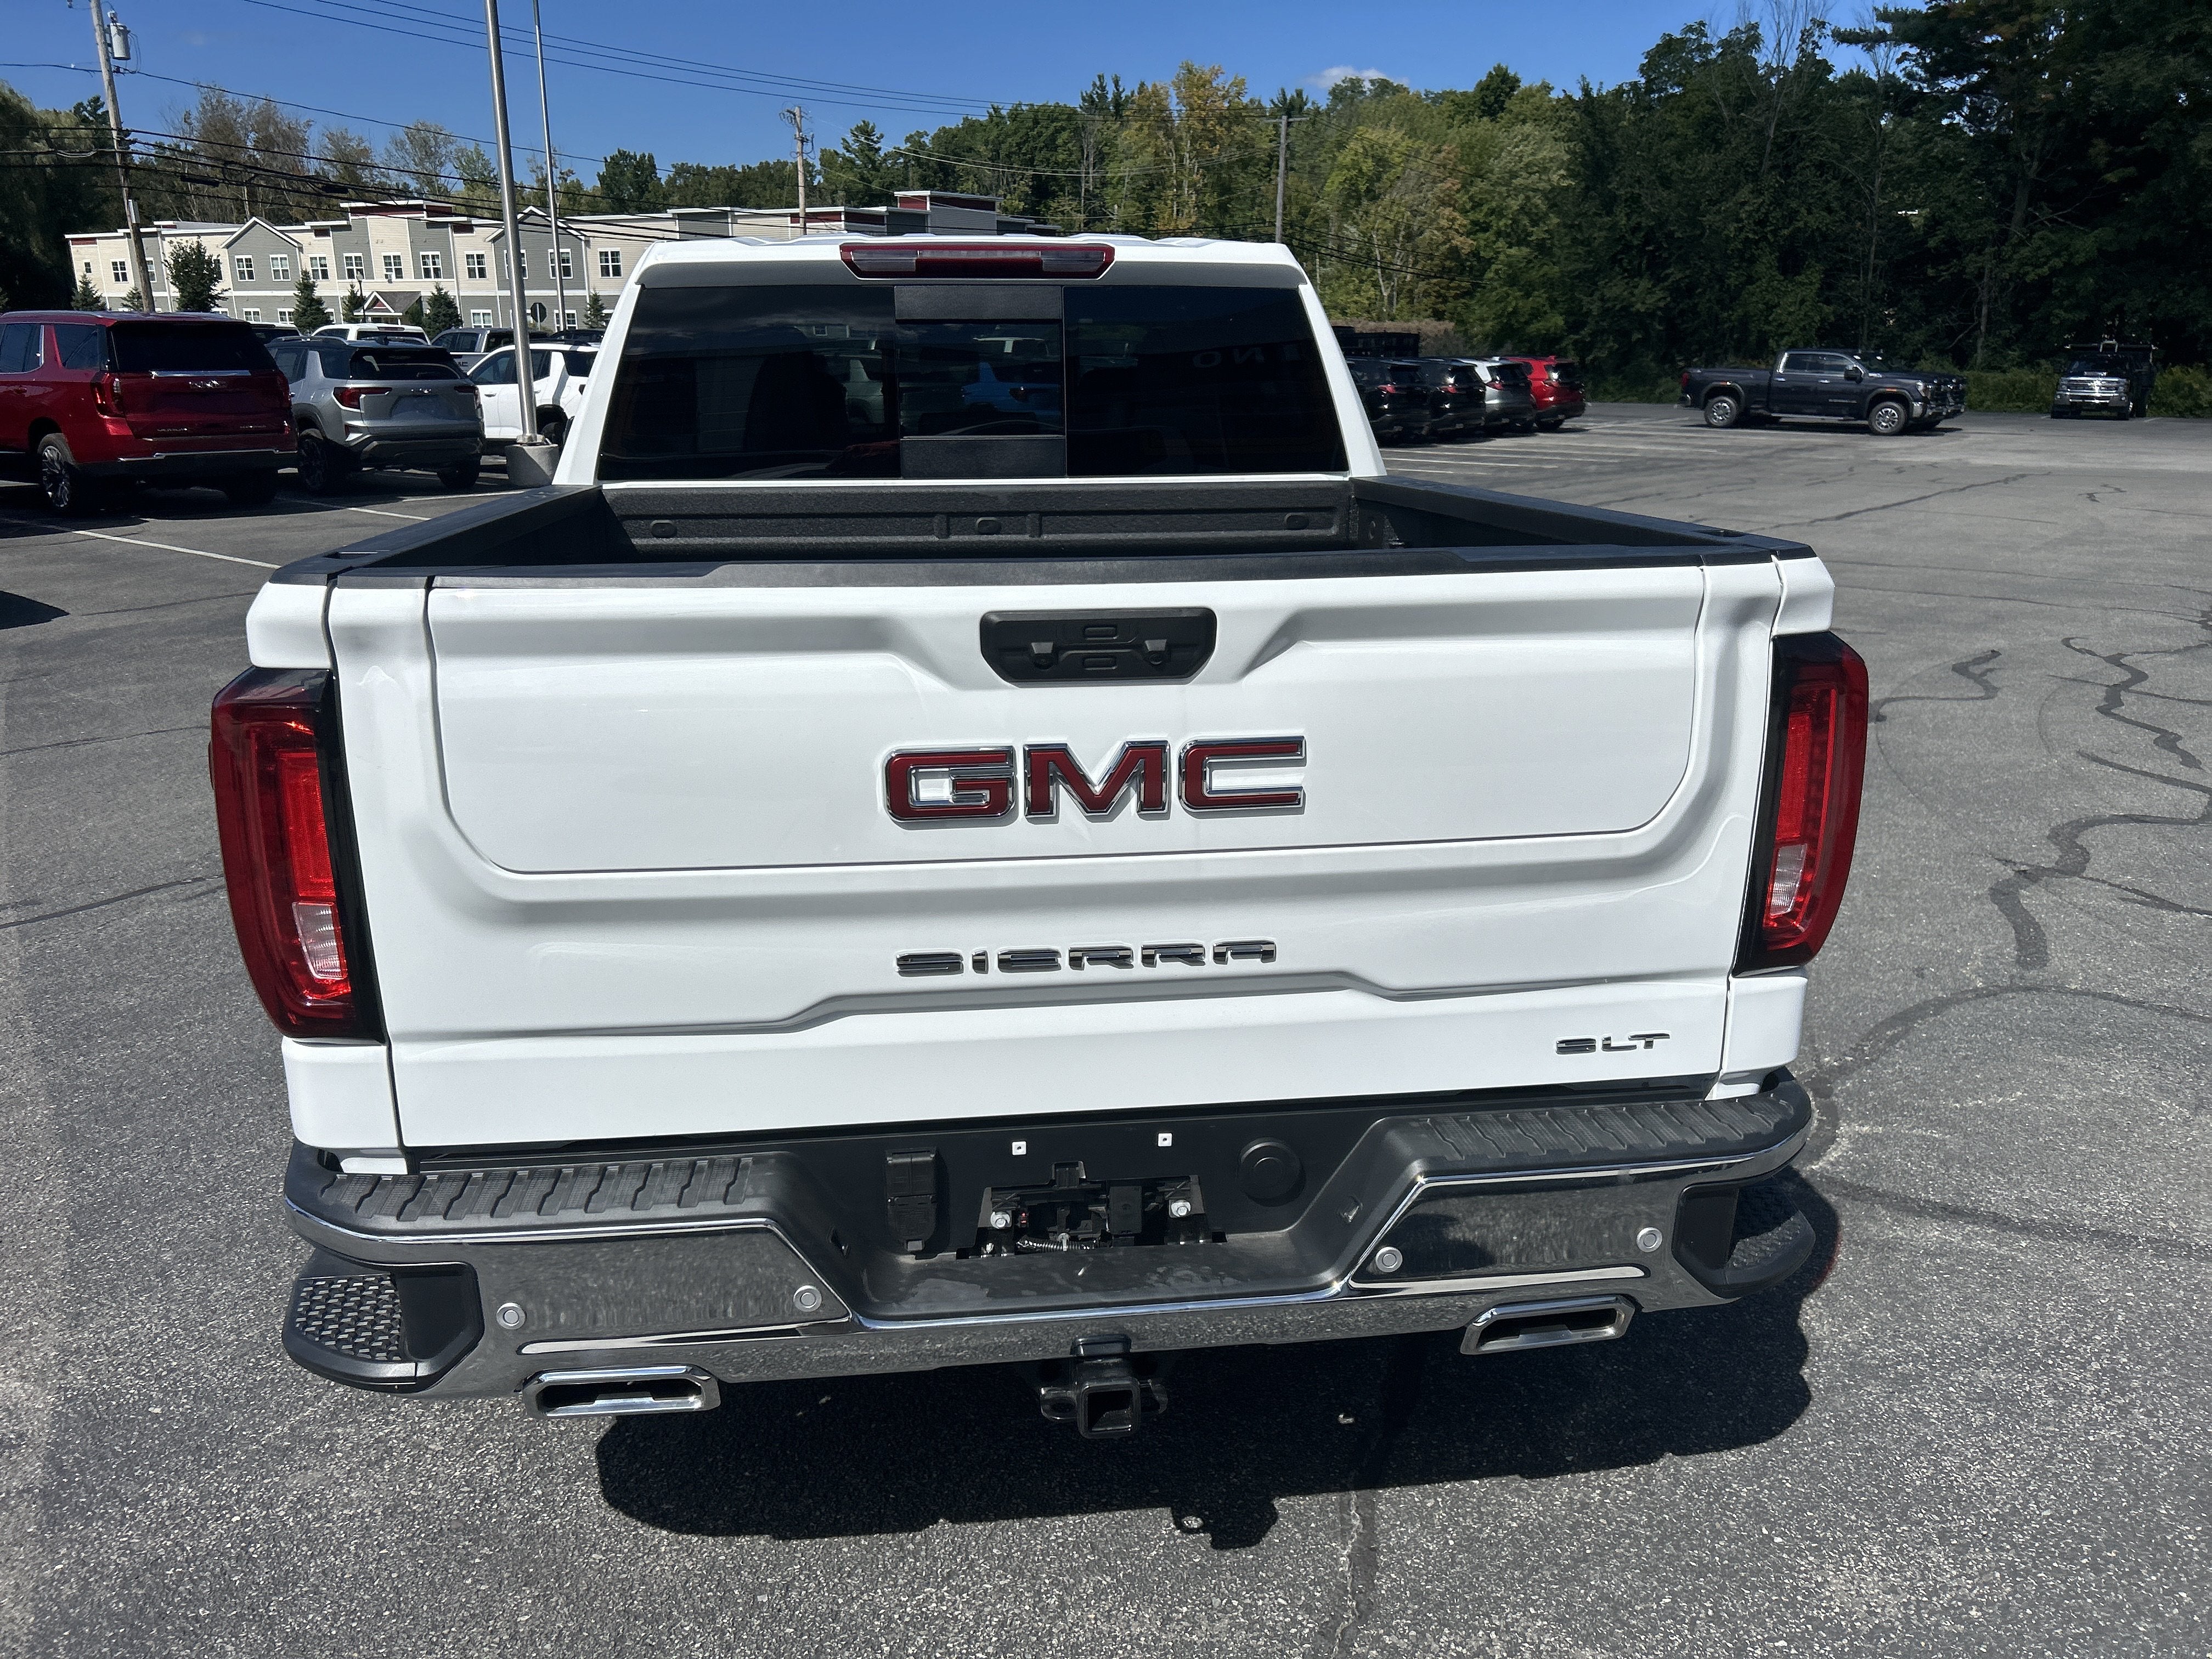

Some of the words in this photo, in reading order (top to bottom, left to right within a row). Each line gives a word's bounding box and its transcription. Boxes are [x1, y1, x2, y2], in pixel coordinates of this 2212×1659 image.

[885, 735, 1306, 824] GMC
[896, 940, 1277, 977] SIERRA
[1556, 1032, 1671, 1054] SLT
